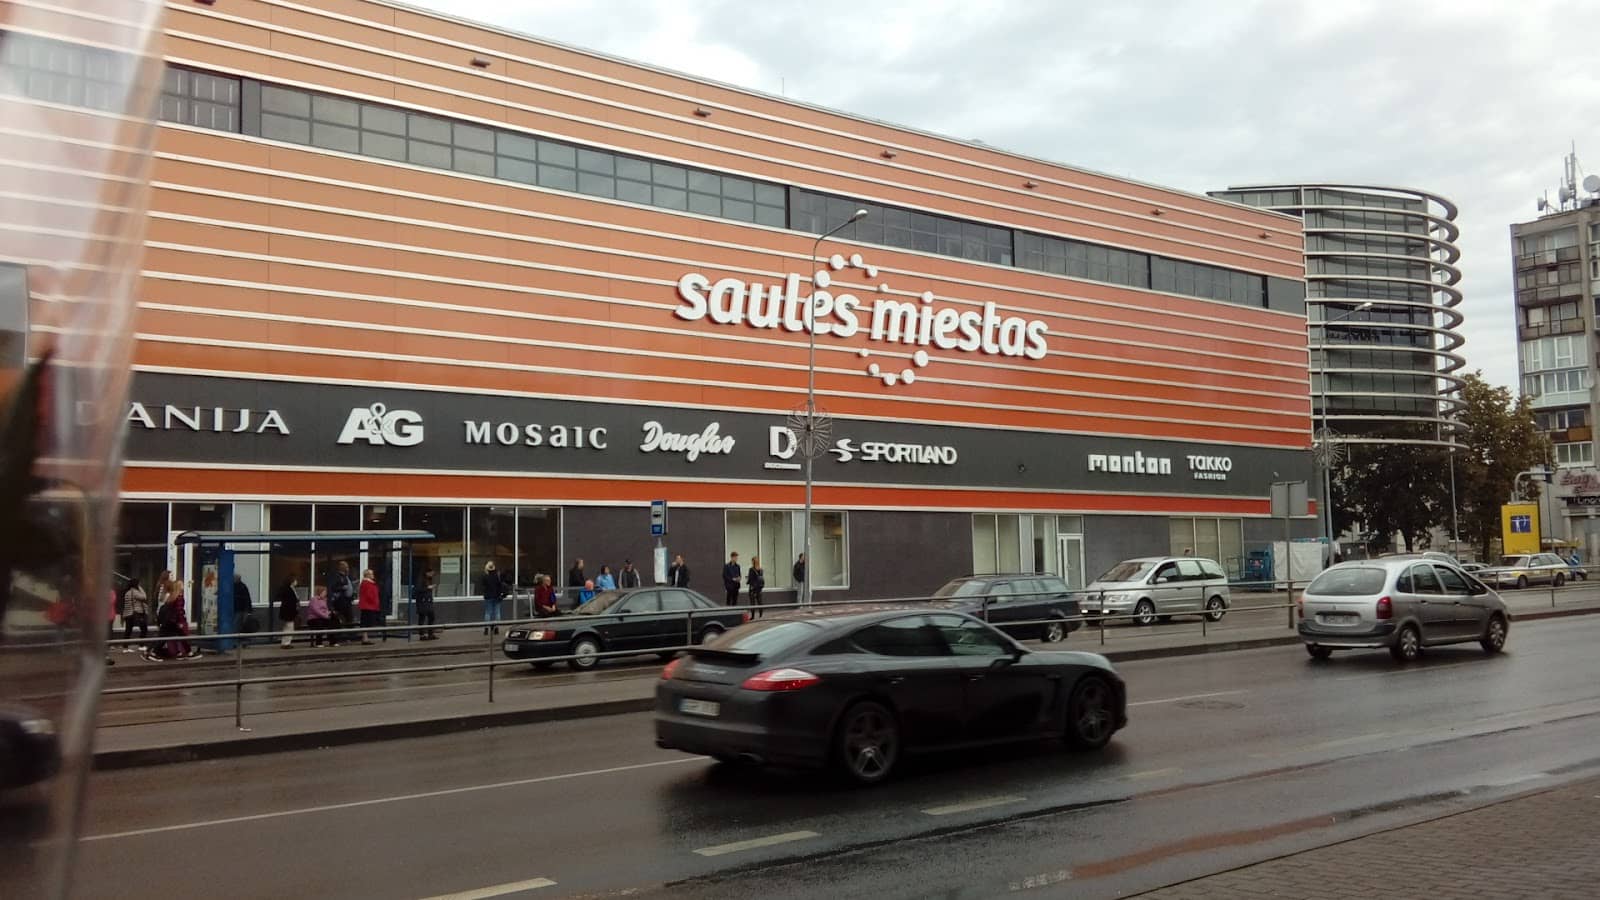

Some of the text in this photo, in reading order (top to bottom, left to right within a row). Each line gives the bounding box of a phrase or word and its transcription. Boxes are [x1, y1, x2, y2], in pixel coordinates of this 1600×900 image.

[870, 290, 1048, 360] miestas
[337, 402, 424, 446] A&G
[861, 441, 958, 465] SPORTLAND
